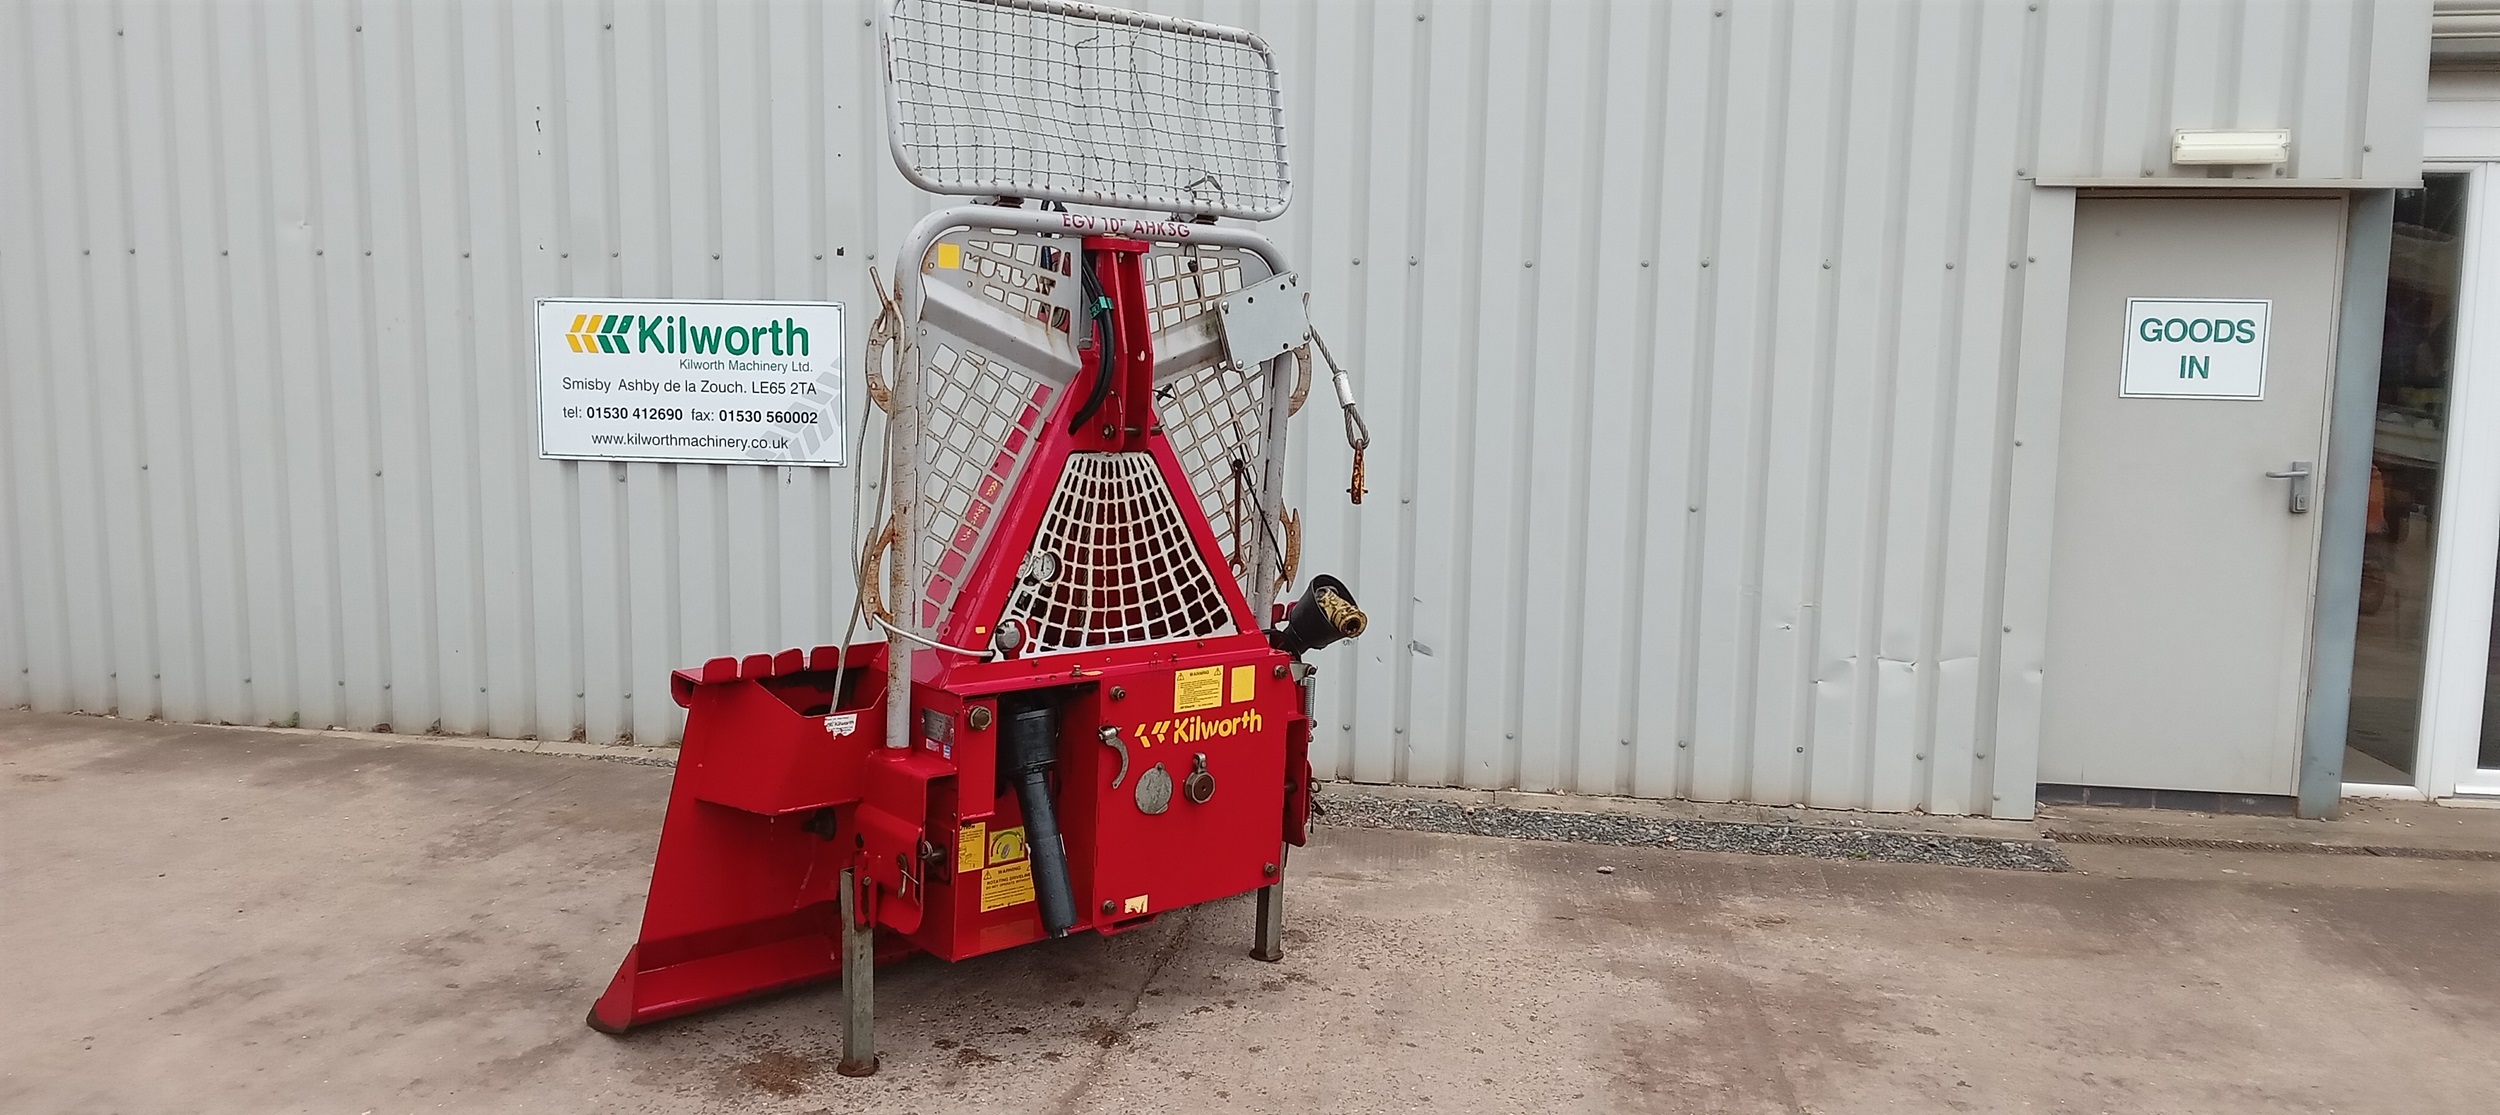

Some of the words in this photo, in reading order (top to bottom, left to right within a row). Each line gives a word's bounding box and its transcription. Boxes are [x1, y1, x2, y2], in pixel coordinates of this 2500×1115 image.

[1062, 213, 1095, 229] EGV
[638, 315, 809, 356] Kilworth
[2139, 317, 2256, 344] GOODS
[679, 358, 725, 371] Kilworth
[728, 359, 788, 374] Machinery
[791, 361, 813, 372] Ltd.
[2179, 355, 2210, 379] IN
[562, 376, 611, 394] Smisby
[618, 378, 660, 395] Ashby
[663, 379, 681, 392] de
[685, 379, 697, 393] la
[700, 379, 747, 394] Zouch.
[752, 381, 786, 394] LE65
[790, 381, 817, 395] 2TA
[562, 406, 582, 419] tel:
[586, 406, 628, 419] 01530
[632, 407, 683, 421] 412690
[691, 408, 715, 421] fax:
[719, 409, 762, 423] 01530
[766, 410, 818, 424] 560002
[591, 432, 789, 452] www.kilworthmachinery.co.uk
[1174, 708, 1262, 744] Kilworth
